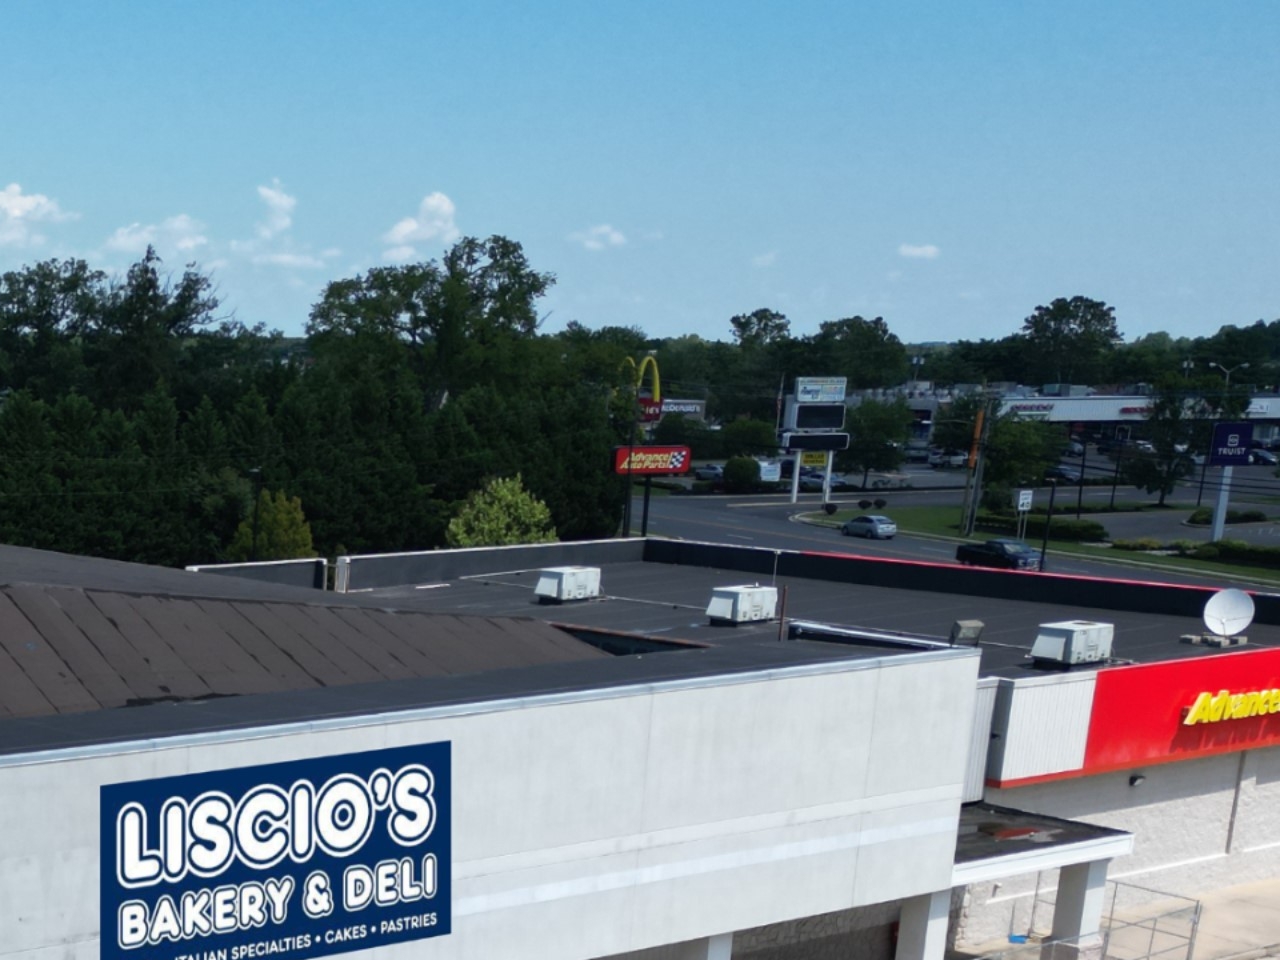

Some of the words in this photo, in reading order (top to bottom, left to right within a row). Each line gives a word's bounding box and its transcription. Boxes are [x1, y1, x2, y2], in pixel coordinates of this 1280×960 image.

[1218, 447, 1246, 455] TRUIST
[1183, 688, 1280, 726] Advance
[117, 764, 436, 888] LISCIO'S
[118, 876, 294, 949] BAKERY
[303, 870, 333, 918] &
[343, 853, 437, 911] DELI
[231, 934, 311, 960] SPECIALTIES
[324, 926, 367, 944] CAKES
[380, 912, 437, 934] PASTRIES
